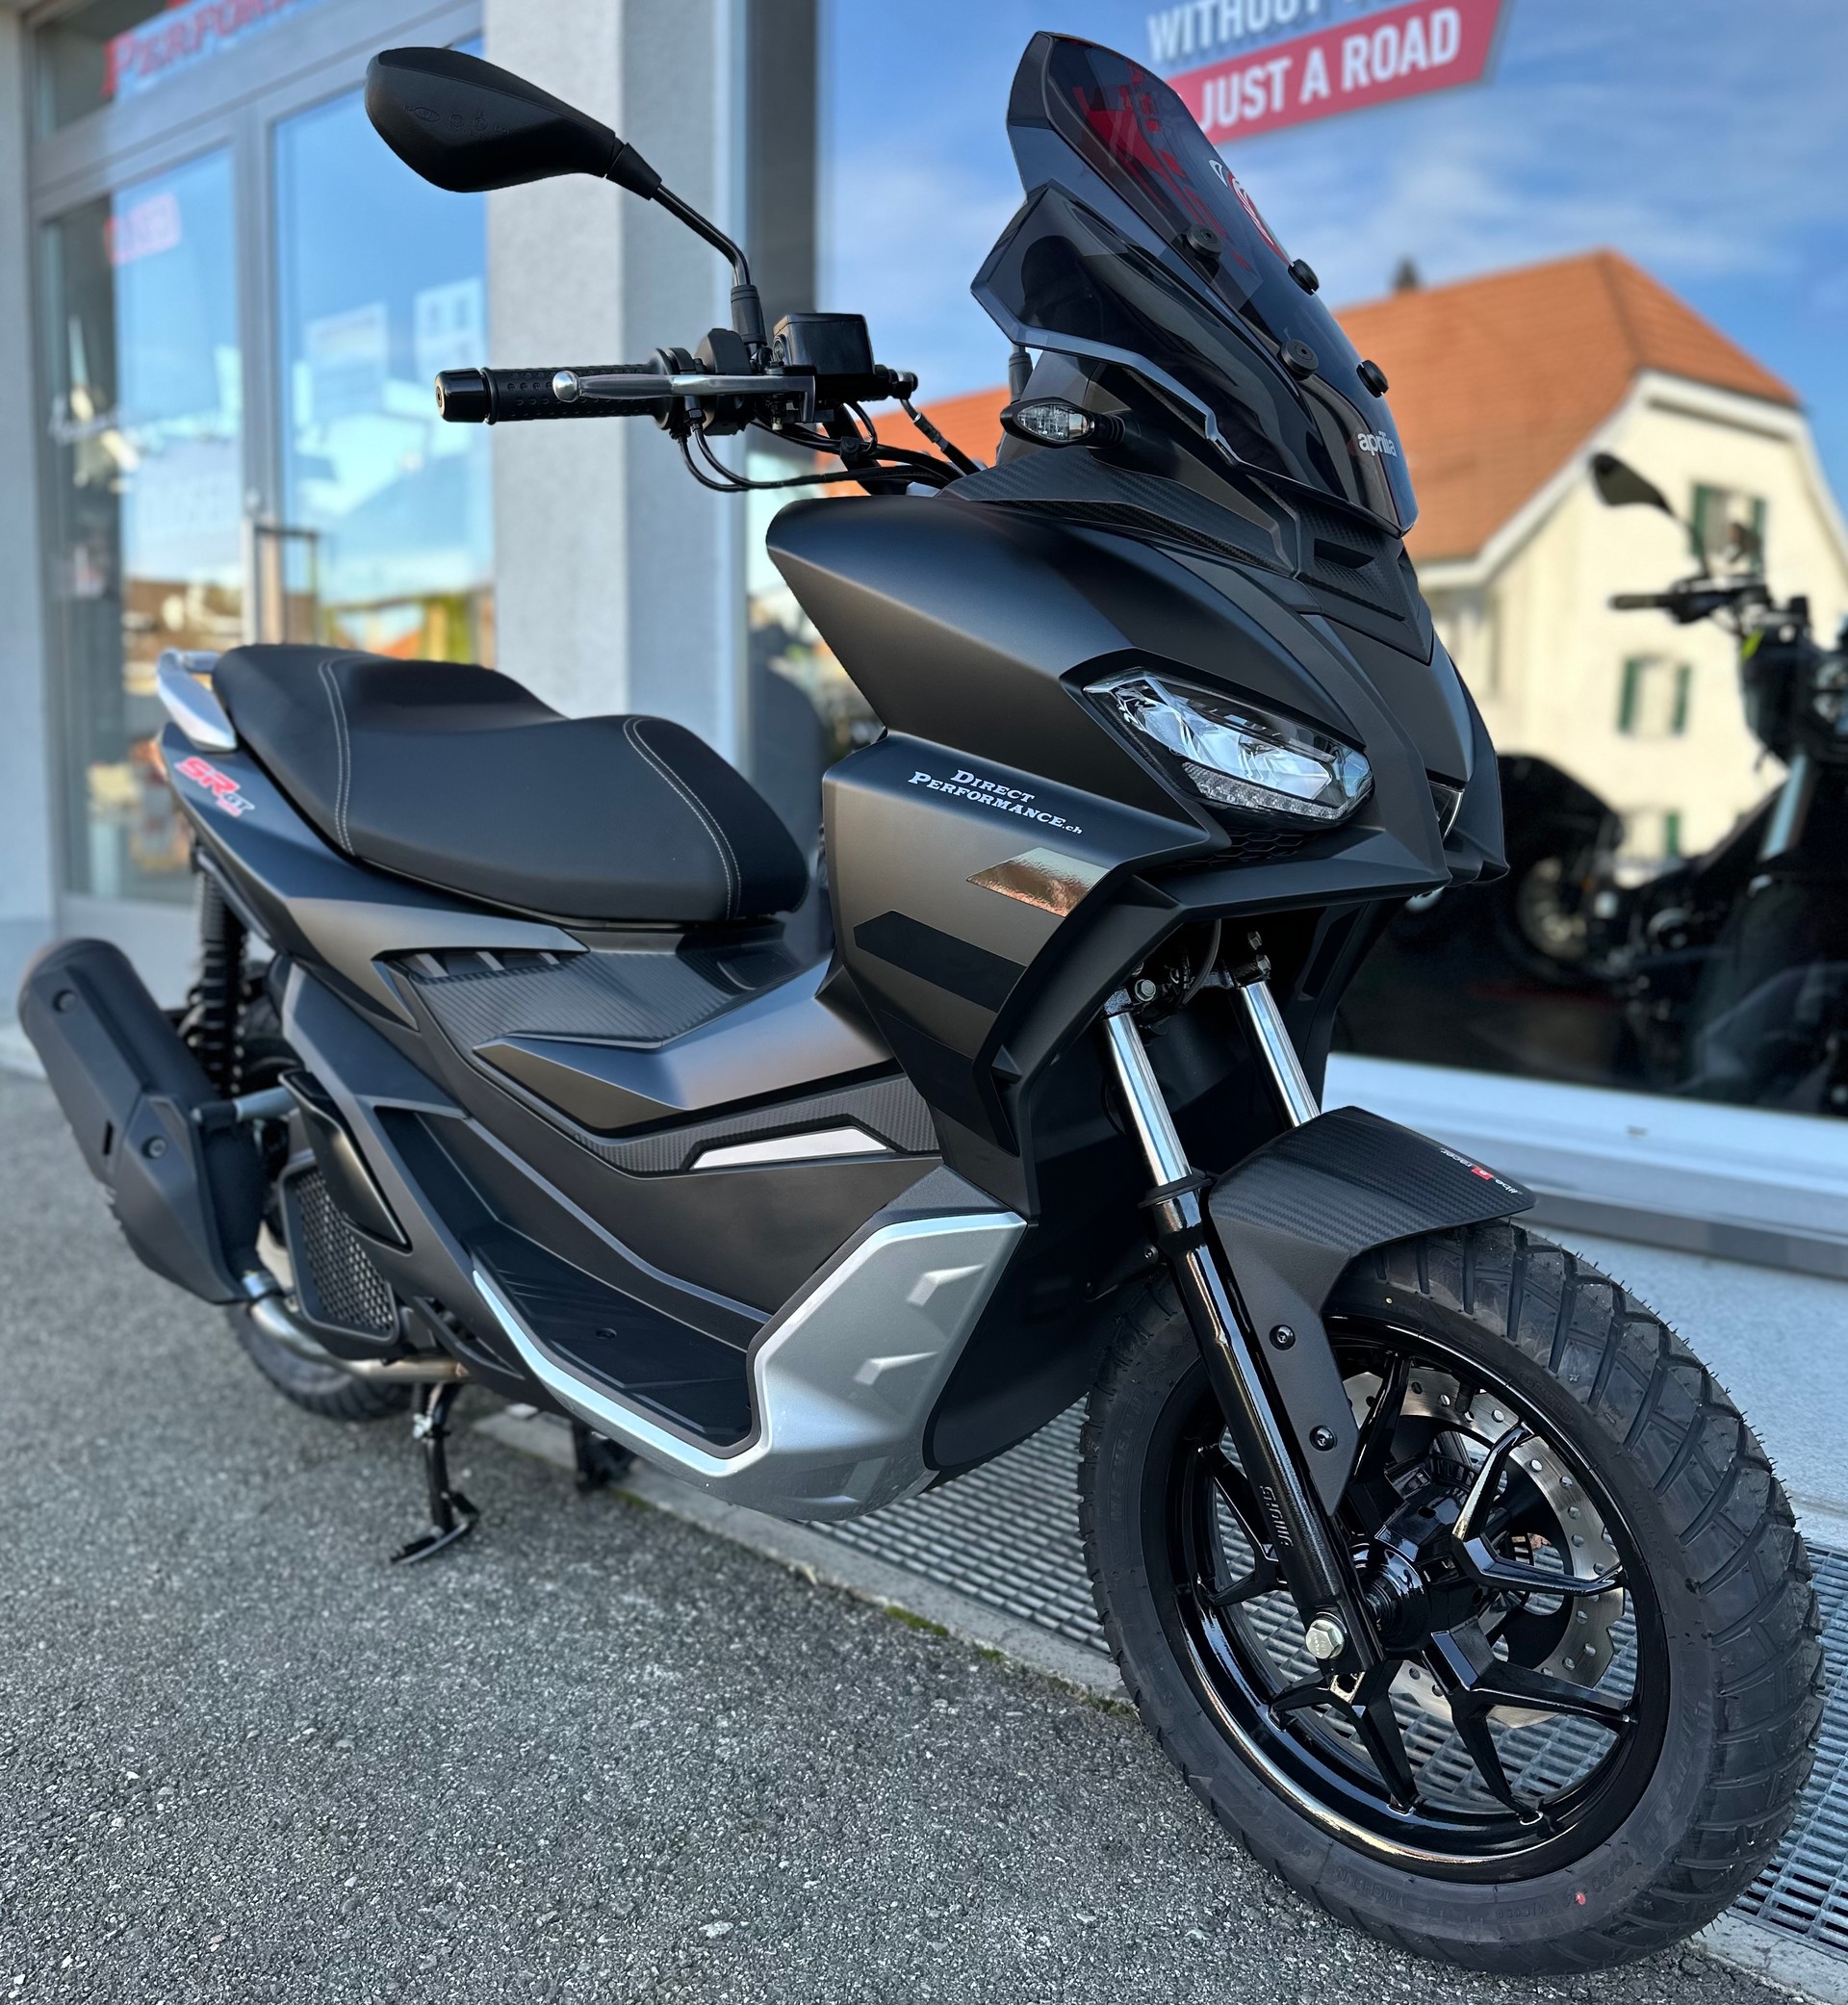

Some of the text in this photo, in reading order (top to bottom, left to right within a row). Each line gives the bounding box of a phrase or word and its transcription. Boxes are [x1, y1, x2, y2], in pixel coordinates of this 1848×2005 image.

[1199, 7, 1462, 131] JUST A ROAD
[1357, 430, 1399, 458] aprilia
[174, 756, 241, 797] SR
[950, 769, 1036, 803] DIRECT
